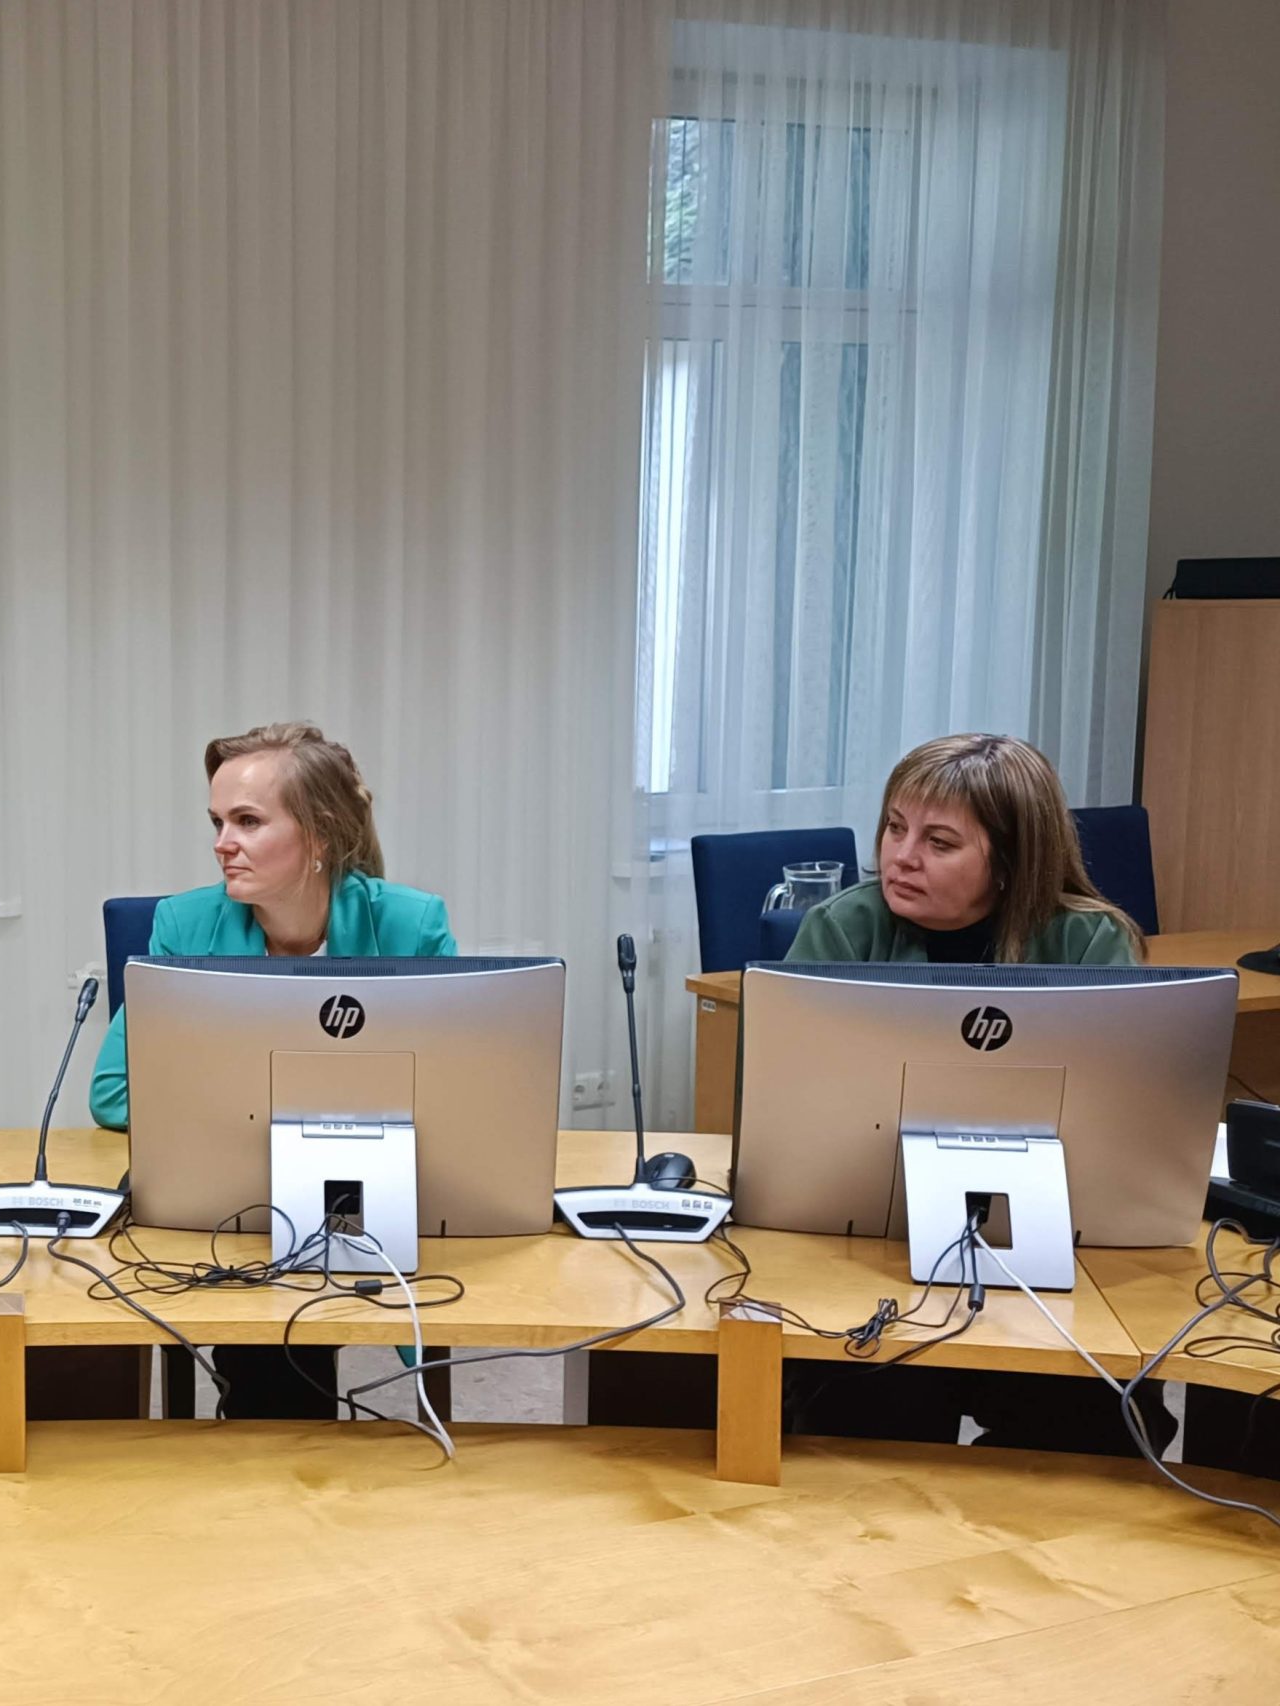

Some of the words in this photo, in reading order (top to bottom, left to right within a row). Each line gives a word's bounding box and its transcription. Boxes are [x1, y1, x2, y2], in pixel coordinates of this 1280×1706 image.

[324, 994, 361, 1040] hp
[966, 1005, 1008, 1051] hp
[28, 1196, 65, 1207] BOSCH
[631, 1199, 671, 1211] BOSCH
